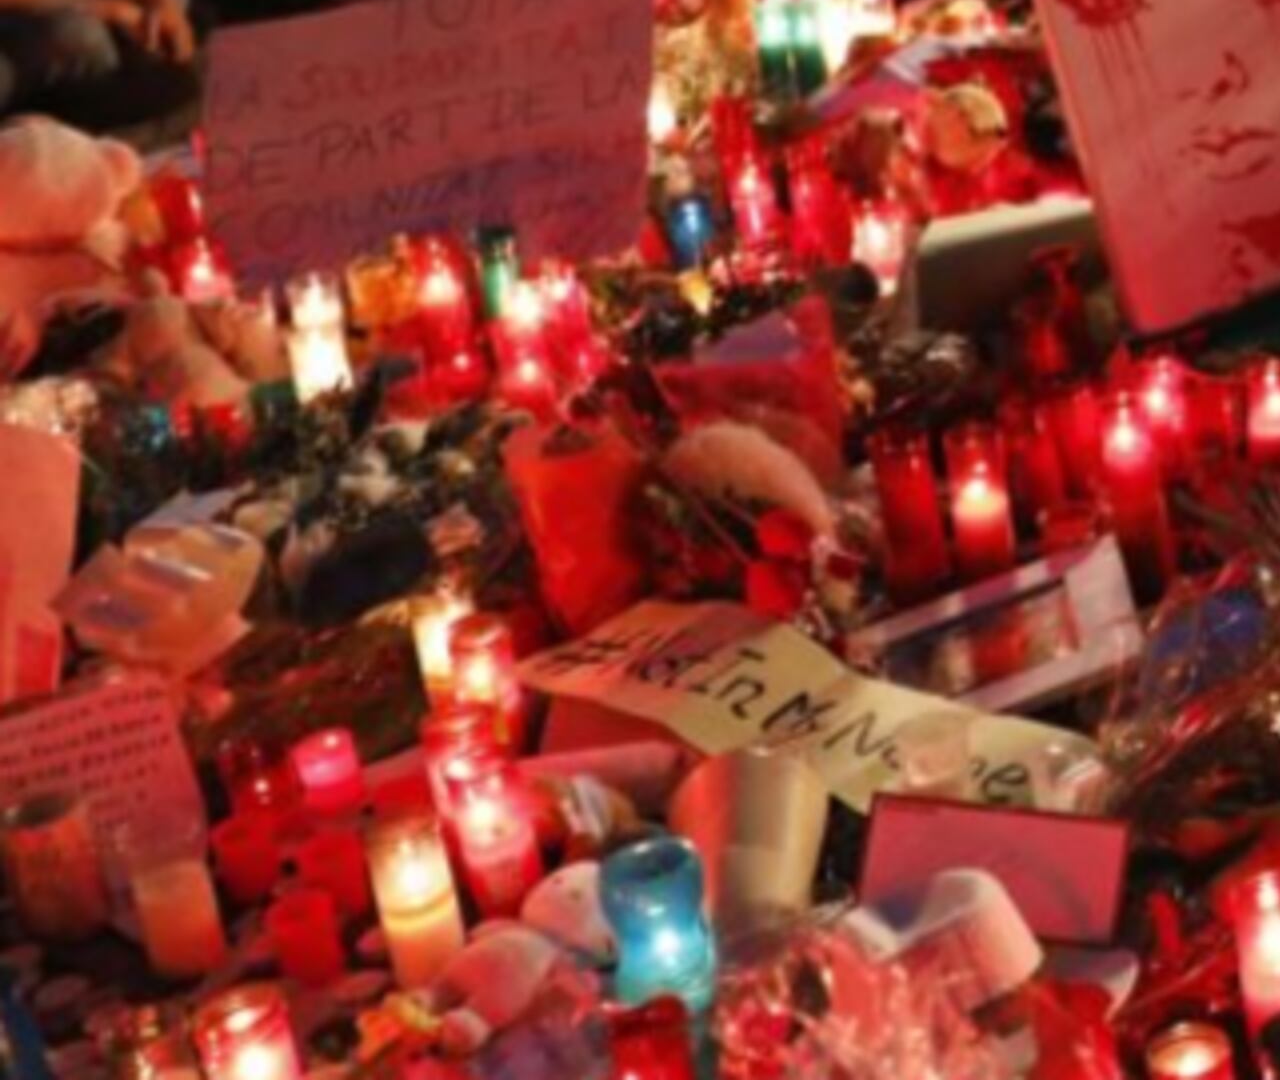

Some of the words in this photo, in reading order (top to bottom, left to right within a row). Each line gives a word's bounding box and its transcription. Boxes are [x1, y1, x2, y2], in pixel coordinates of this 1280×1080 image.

[203, 138, 292, 192] DE
[302, 96, 468, 173] PART
[481, 80, 562, 133] DE
[581, 59, 639, 112] LA
